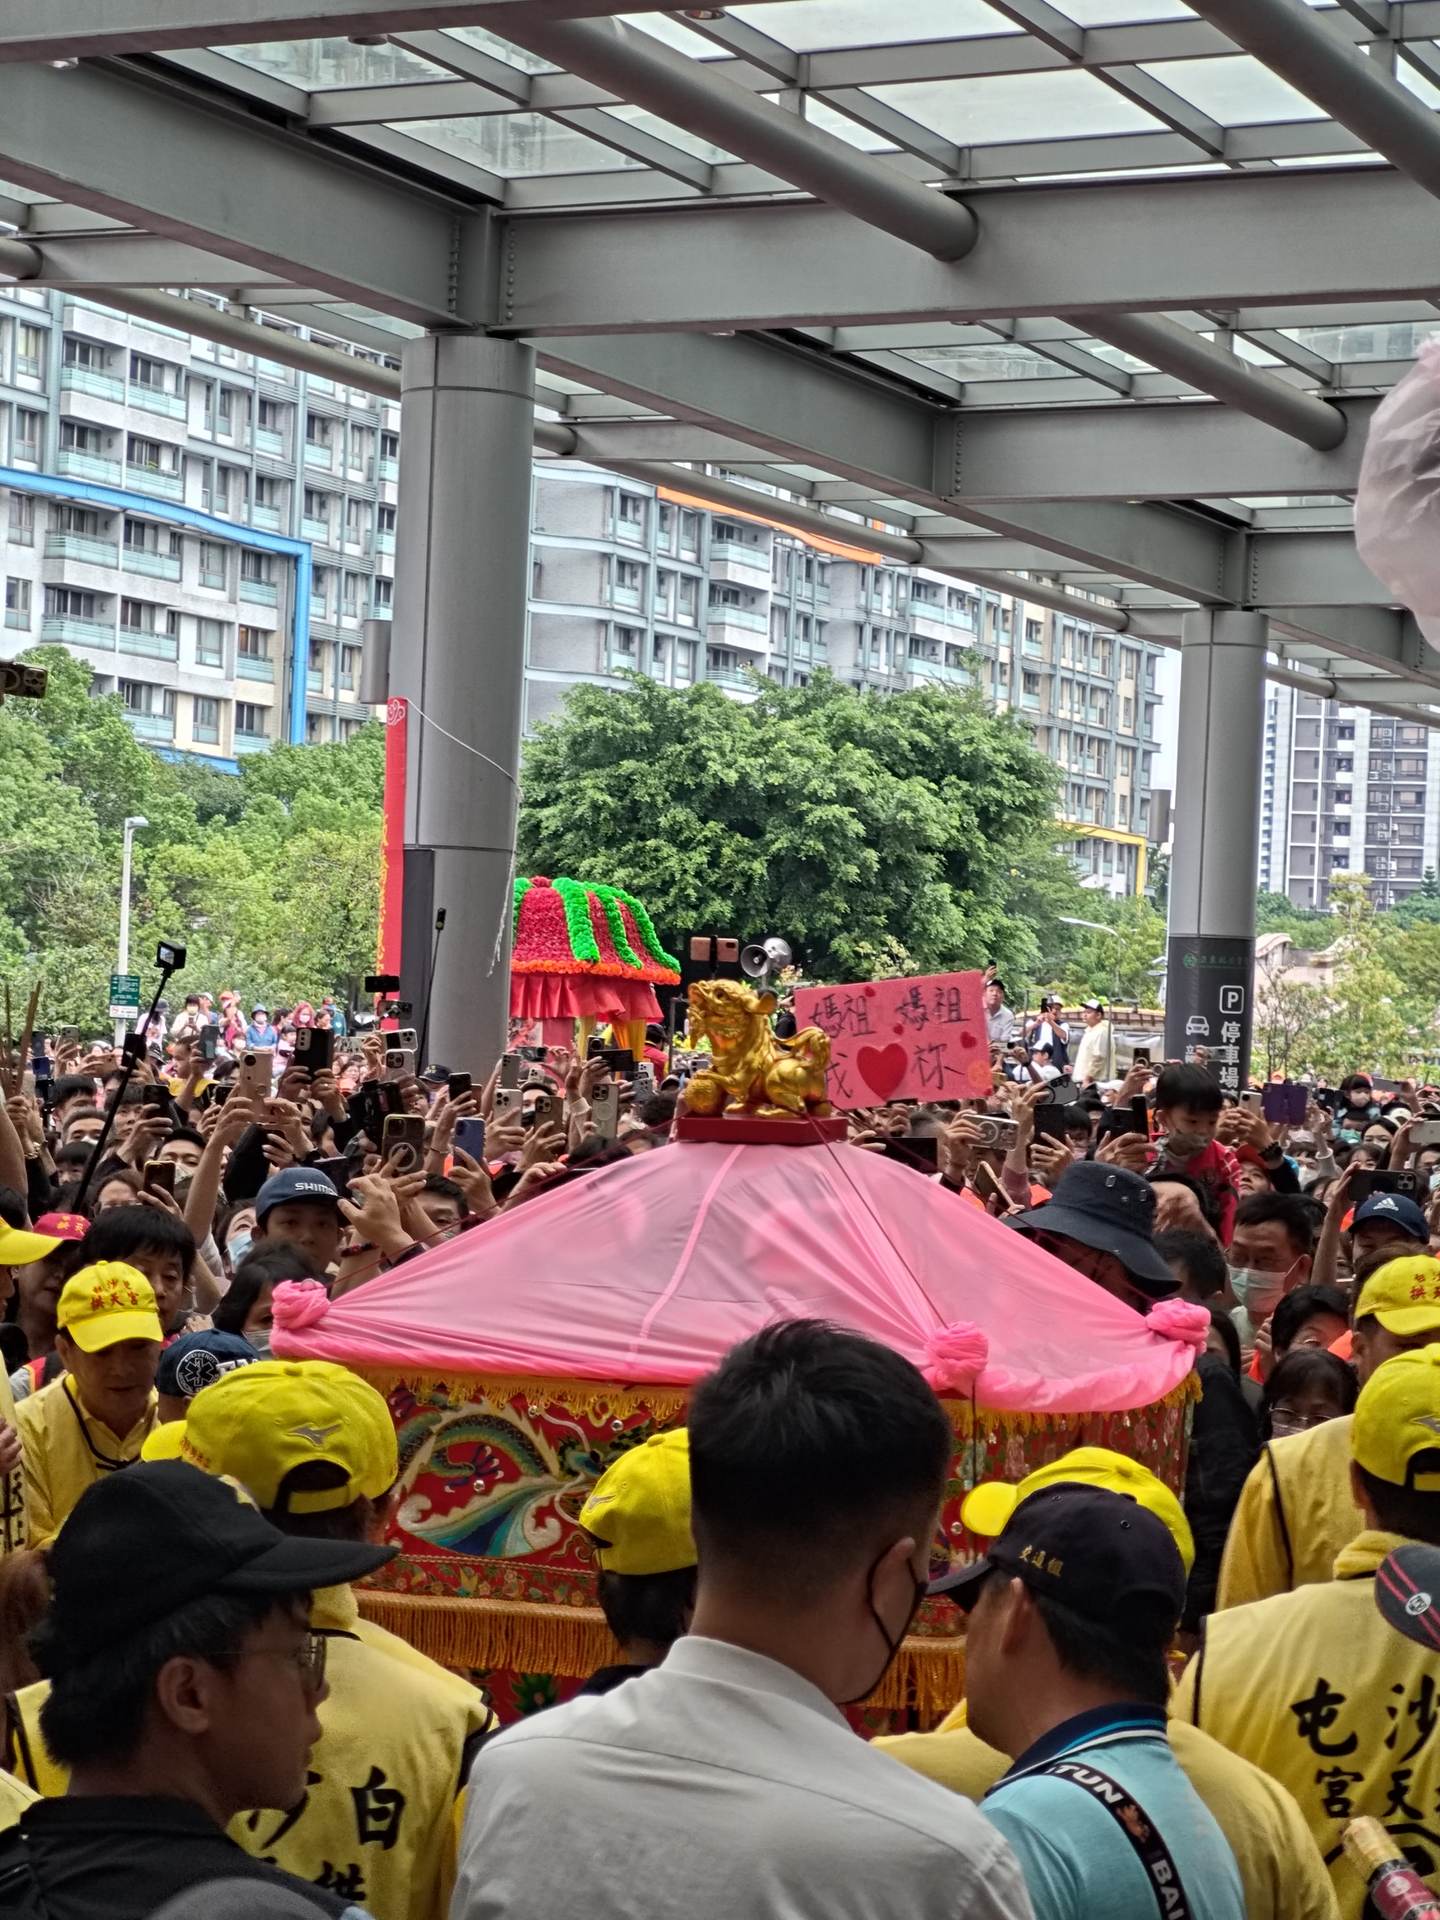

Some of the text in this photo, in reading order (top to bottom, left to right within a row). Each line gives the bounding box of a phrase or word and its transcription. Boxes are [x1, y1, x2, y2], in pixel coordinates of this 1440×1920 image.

[1227, 991, 1239, 1008] P
[1219, 1021, 1241, 1096] 停車場
